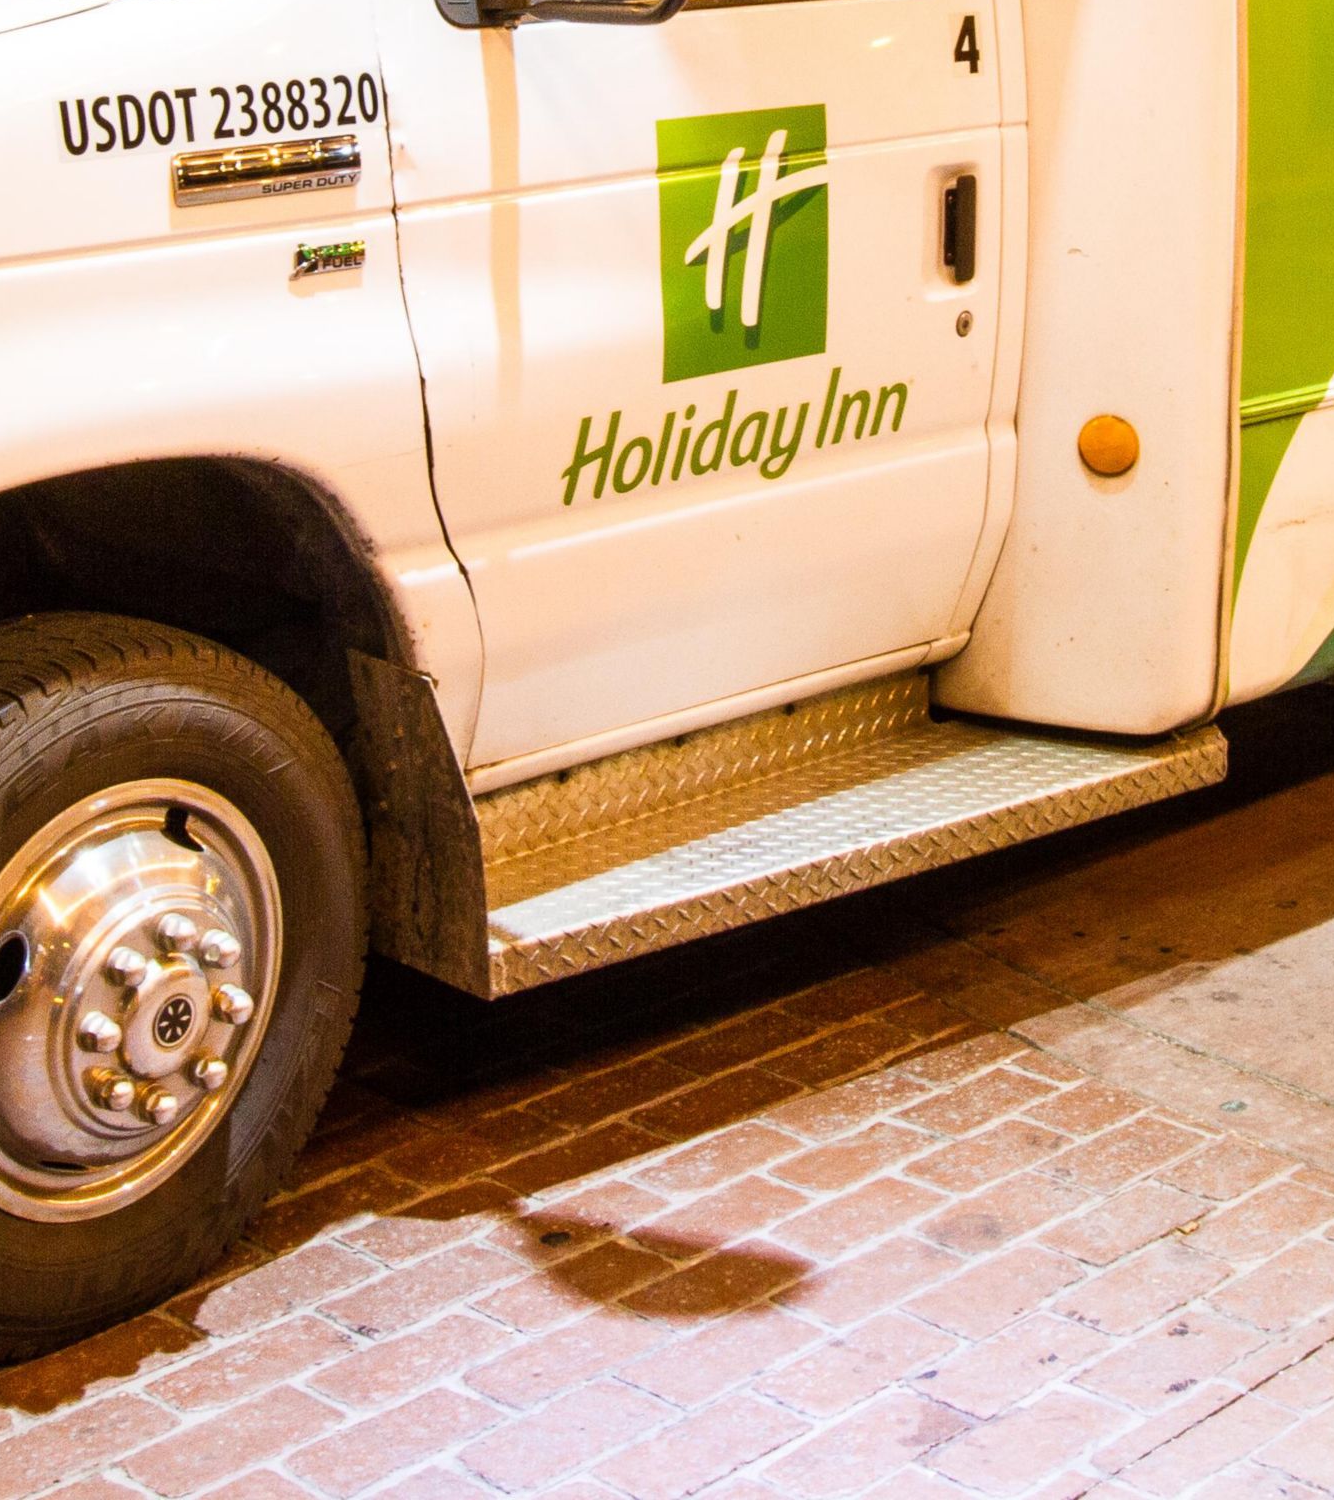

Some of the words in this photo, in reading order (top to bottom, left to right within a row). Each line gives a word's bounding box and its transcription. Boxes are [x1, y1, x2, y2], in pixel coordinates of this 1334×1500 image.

[953, 15, 980, 74] 4
[59, 87, 198, 156] USDOT
[209, 72, 380, 140] 2388320
[261, 179, 313, 195] SUPER
[316, 173, 357, 189] DUTY
[322, 256, 362, 269] FUEL
[561, 389, 809, 507] Holiday
[815, 366, 909, 450] Inn
